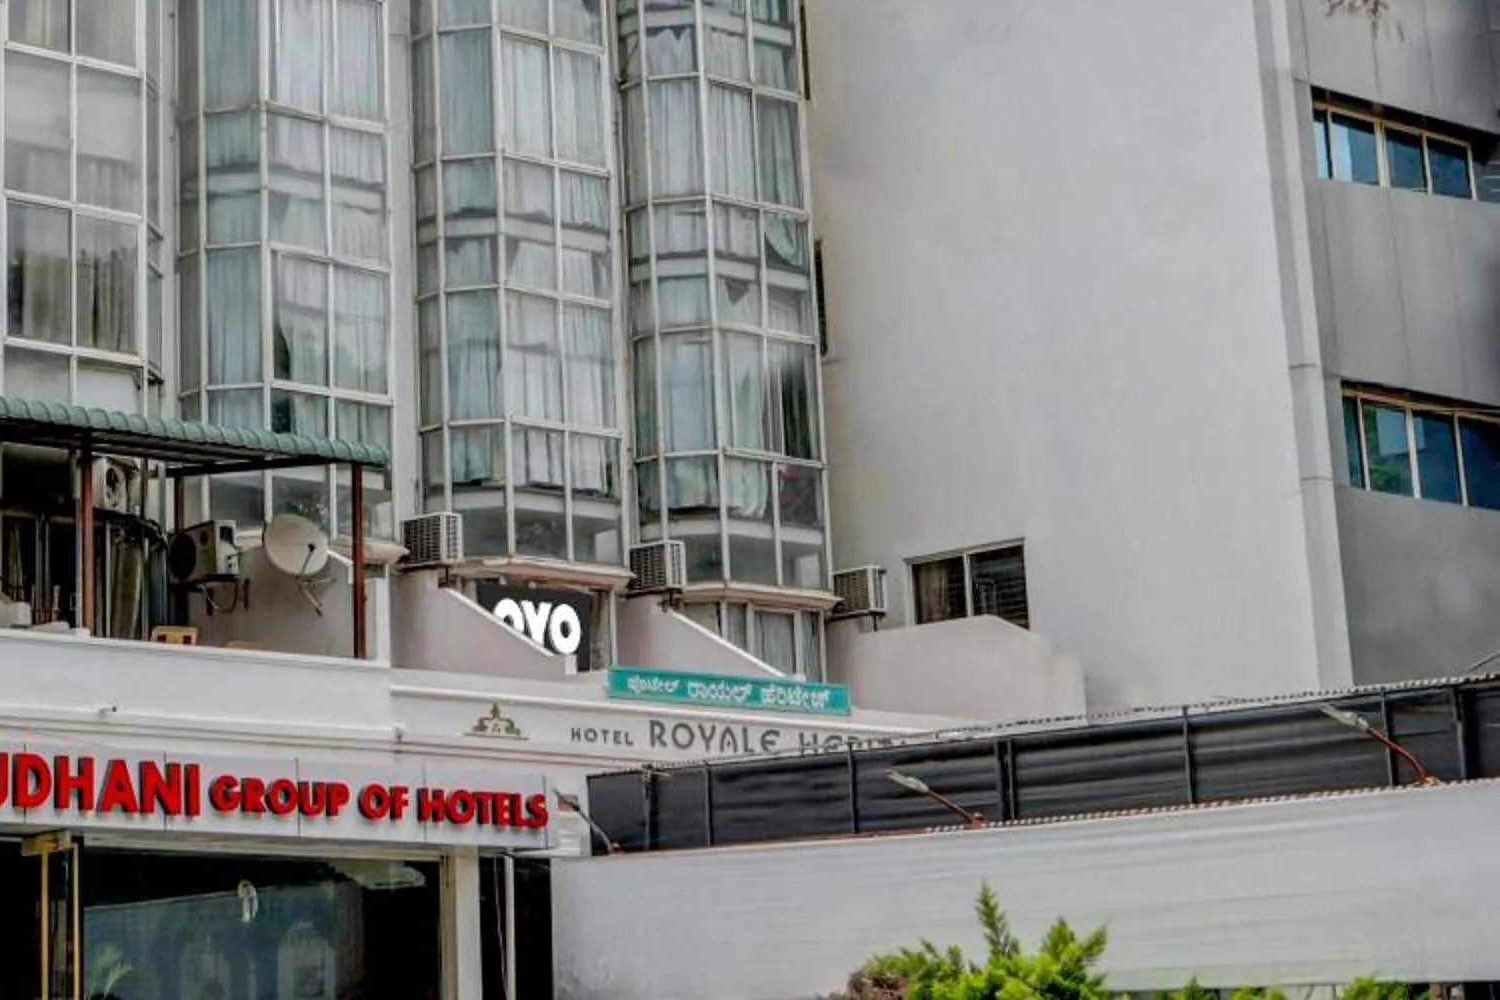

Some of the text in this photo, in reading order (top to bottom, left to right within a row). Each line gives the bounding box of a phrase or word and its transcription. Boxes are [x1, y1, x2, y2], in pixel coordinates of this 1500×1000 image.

[493, 597, 581, 655] OYO
[570, 726, 634, 746] HOTEL
[649, 719, 781, 754] ROYALE
[210, 774, 350, 817] GROUP
[359, 783, 409, 822] OF
[416, 786, 549, 828] HOTELS
